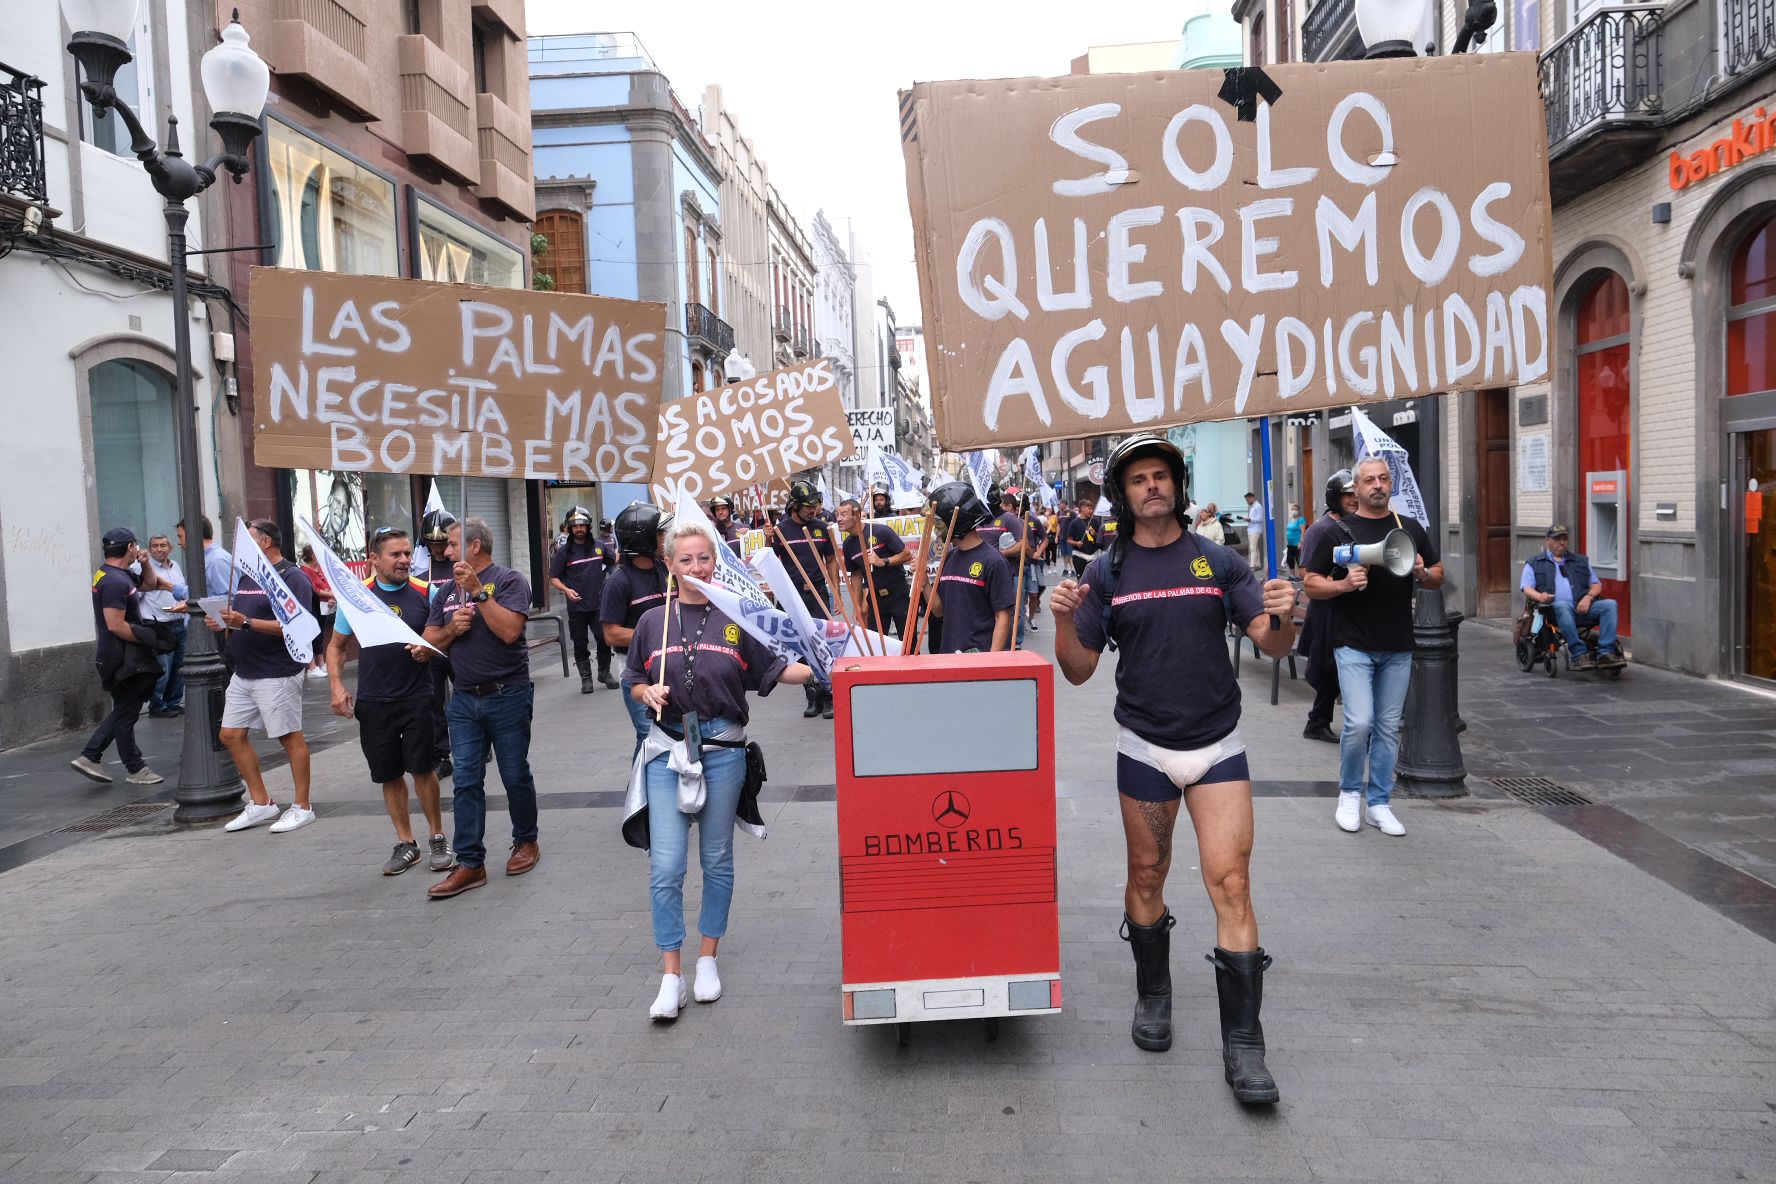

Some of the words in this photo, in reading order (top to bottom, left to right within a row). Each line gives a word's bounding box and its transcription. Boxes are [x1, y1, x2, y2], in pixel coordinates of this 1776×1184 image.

[1050, 92, 1394, 196] SOLO
[957, 182, 1525, 320] QUEREMOS
[302, 286, 411, 358] LAS
[460, 301, 657, 383] PALMAS
[331, 422, 651, 481] BOMBEROS
[544, 389, 650, 446] MAS
[666, 397, 814, 474] SOMOS
[652, 426, 844, 510] NOSOTROS
[1153, 591, 1167, 599] LAS
[1167, 588, 1195, 598] PALMAS
[865, 827, 1023, 857] BOMBEROS
